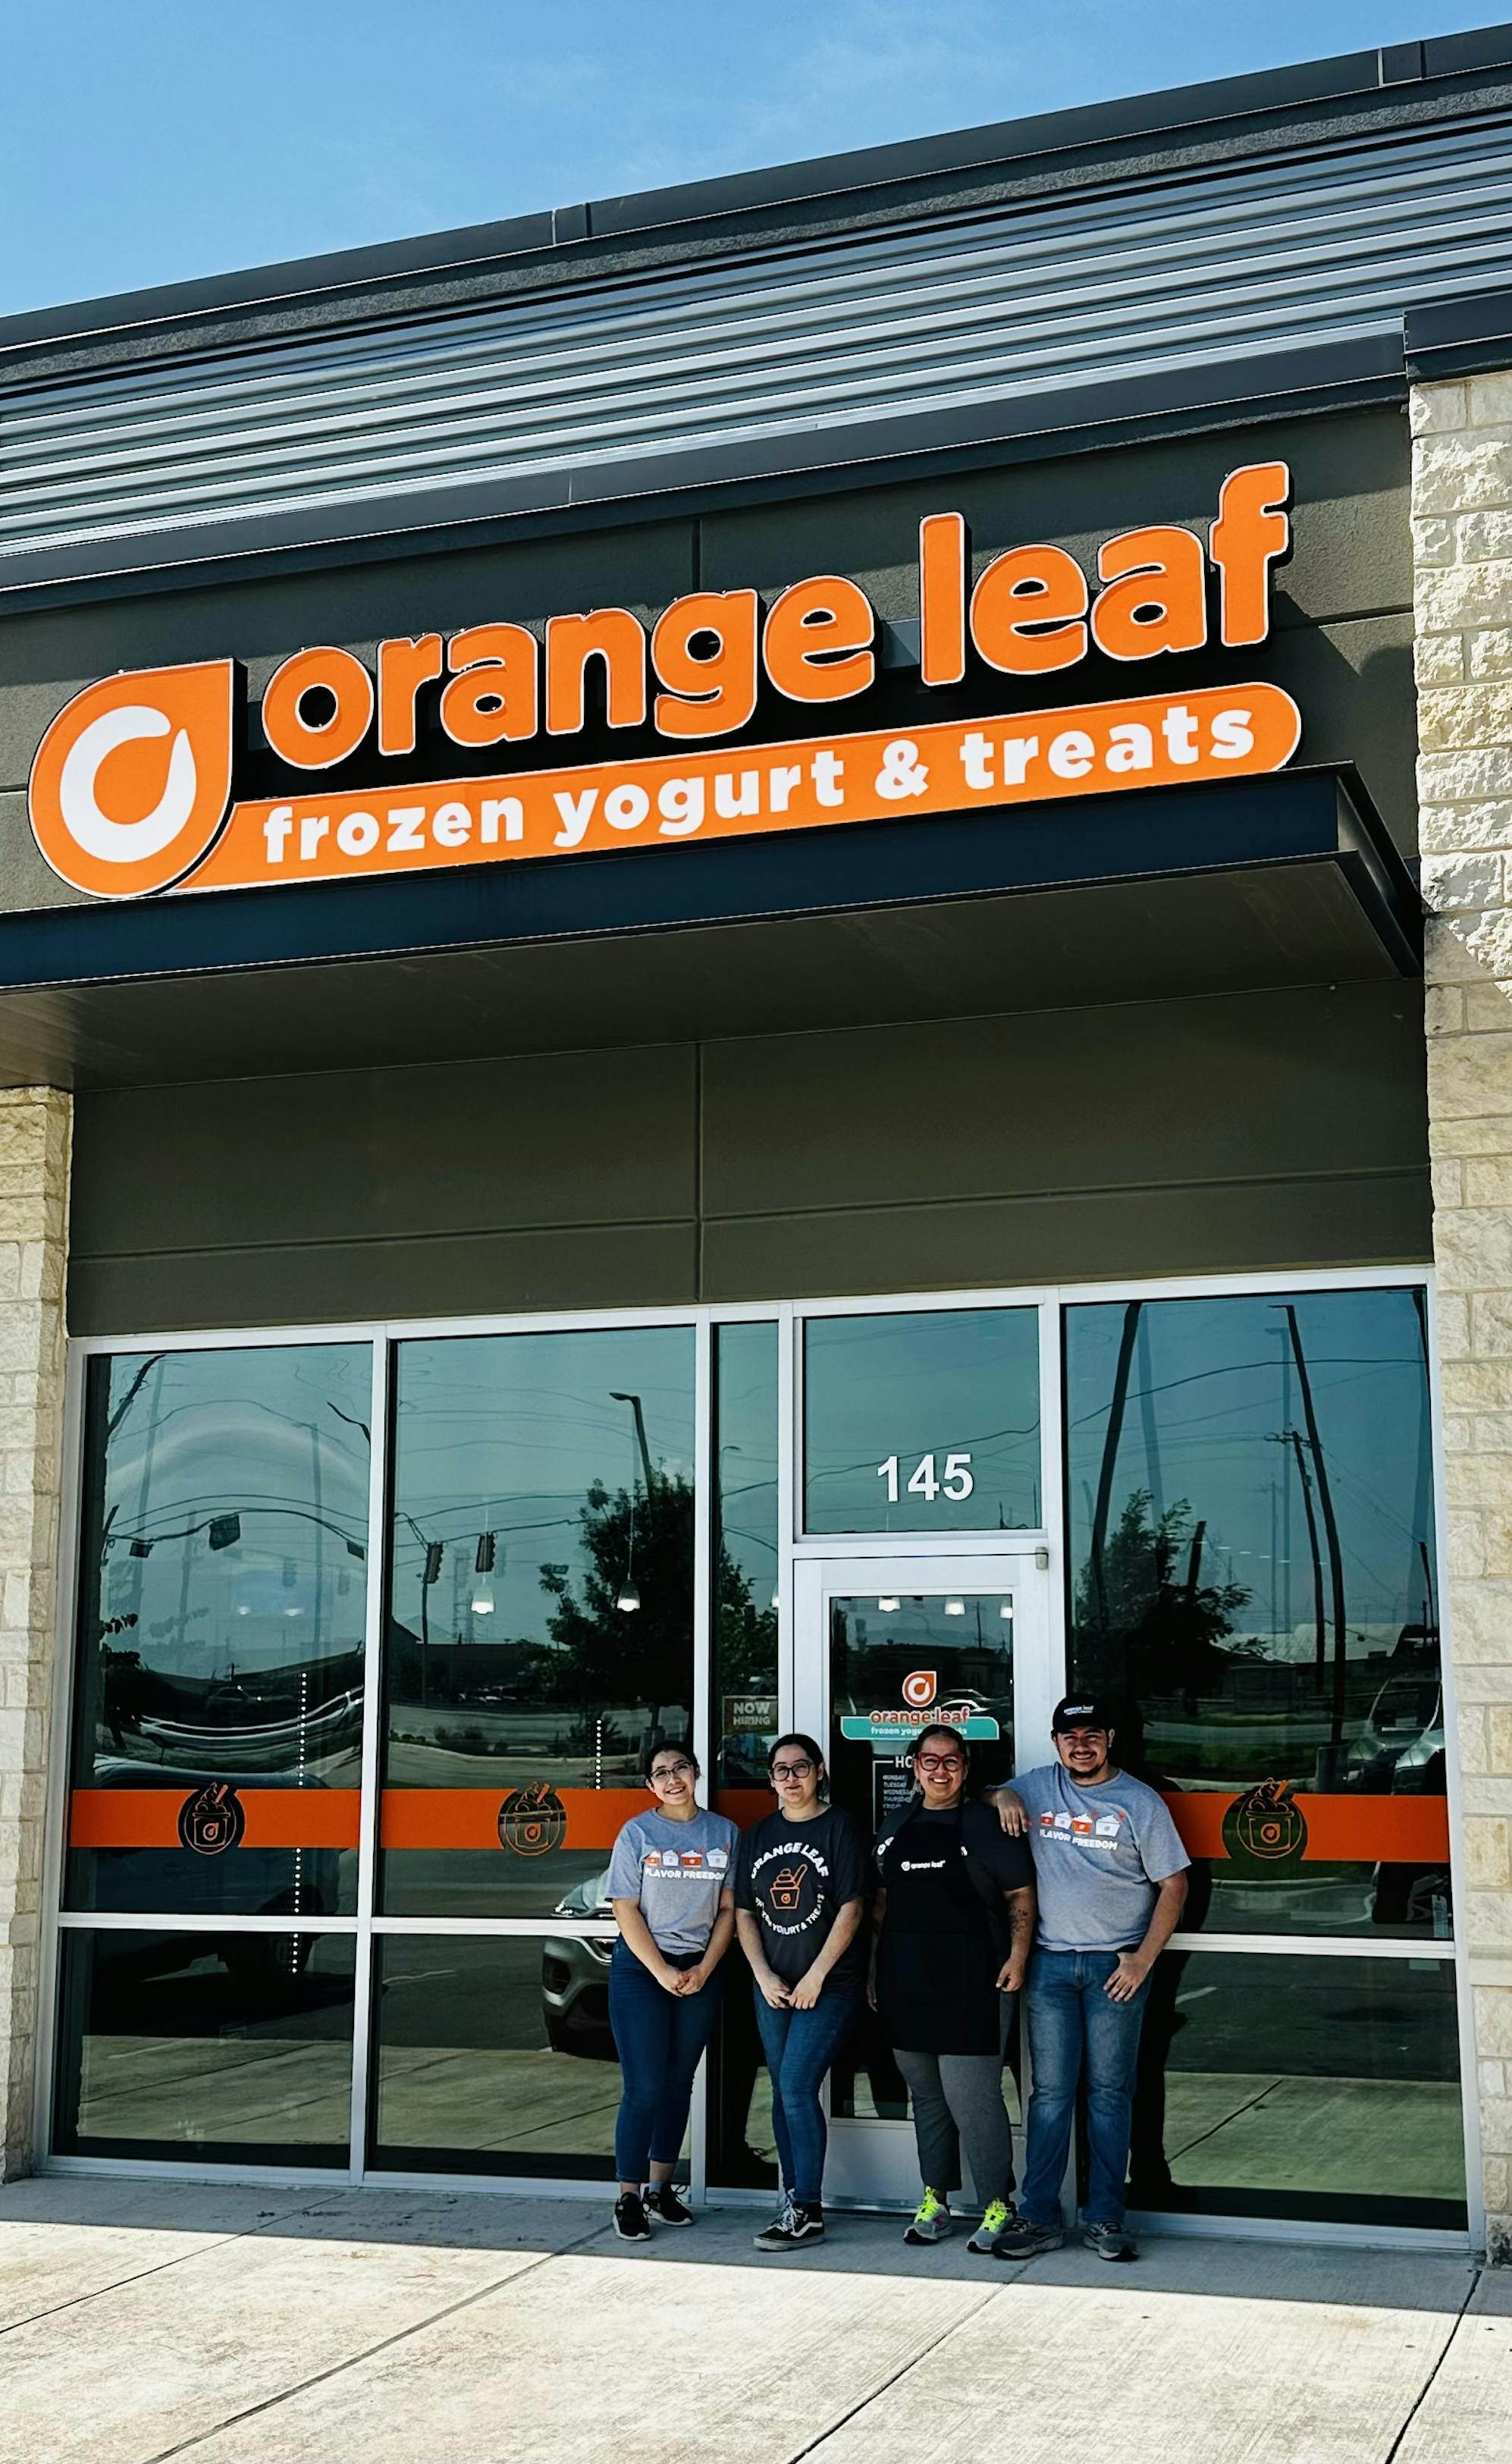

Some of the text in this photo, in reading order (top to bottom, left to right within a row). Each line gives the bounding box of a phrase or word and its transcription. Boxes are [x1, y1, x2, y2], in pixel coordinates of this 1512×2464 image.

[262, 460, 1289, 770] orange leaf
[264, 705, 1254, 863] frozen yogurt & treats
[877, 1454, 974, 1502] 145
[733, 1701, 770, 1714] NOW
[870, 1706, 970, 1725] orange leaf
[733, 1715, 770, 1725] HIRING
[871, 1726, 899, 1734] frozen
[1040, 1828, 1118, 1850] FLAVOR FREEDOM
[801, 1844, 829, 1877] LEAF
[682, 1870, 726, 1880] FREEDO
